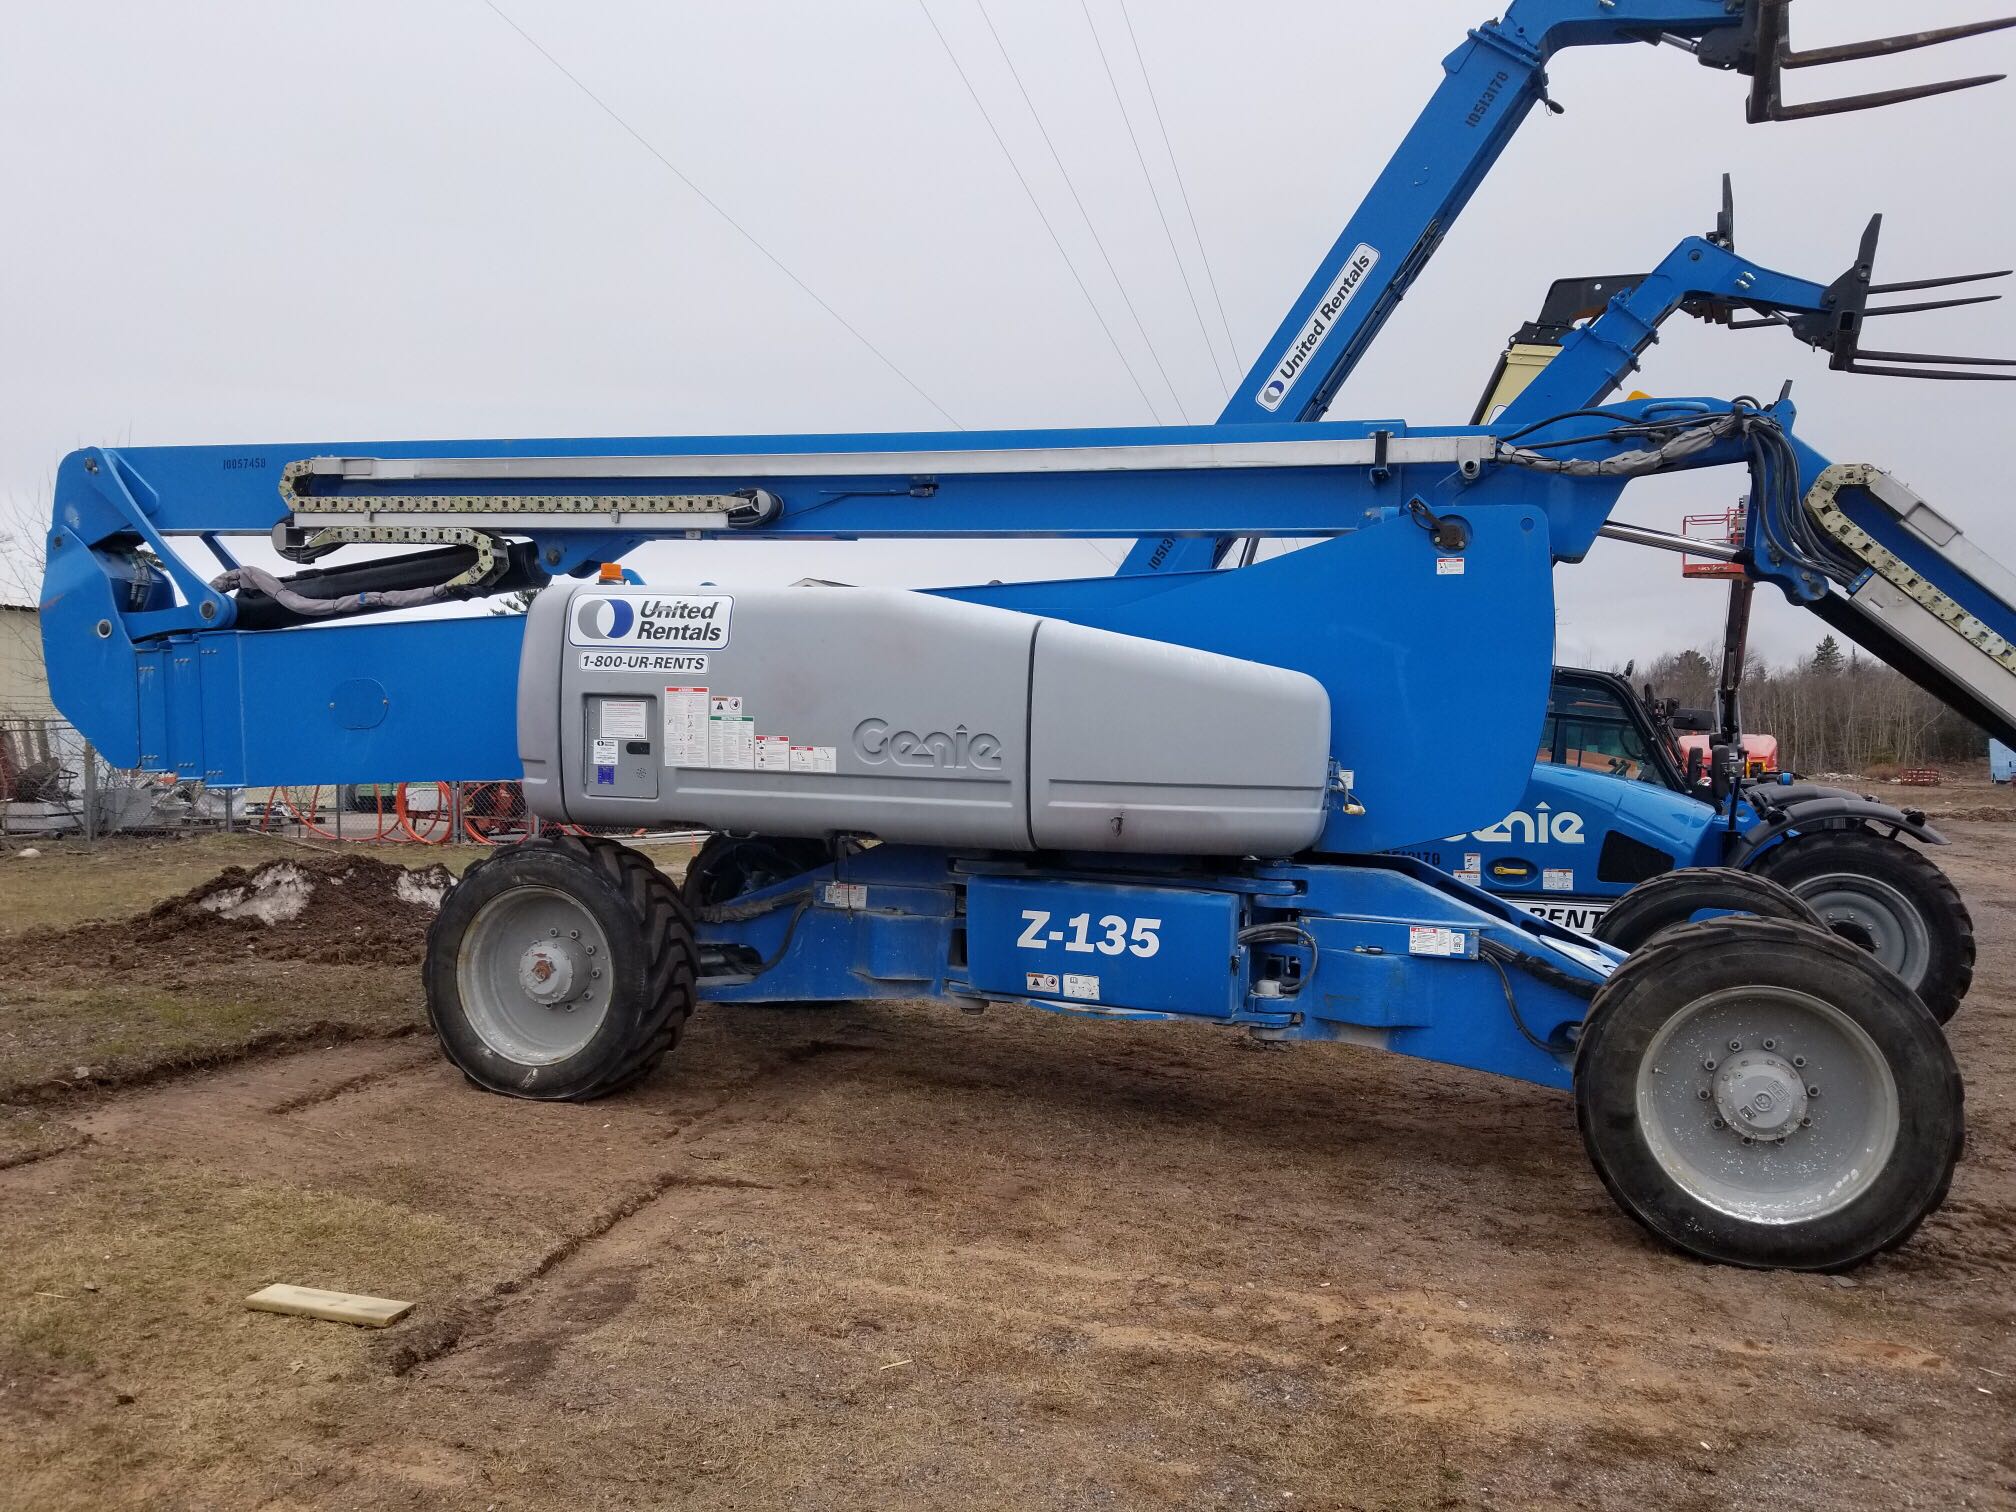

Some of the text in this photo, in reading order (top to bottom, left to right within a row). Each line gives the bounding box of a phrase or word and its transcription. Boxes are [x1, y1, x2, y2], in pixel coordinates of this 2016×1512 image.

[1280, 254, 1370, 380] United Rentals
[636, 620, 722, 642] Rentals
[640, 600, 720, 620] United
[582, 655, 705, 671] 1-800-UR-RENTS
[852, 717, 1002, 771] Genie
[1442, 801, 1585, 843] enie
[1017, 909, 1162, 958] Z-135
